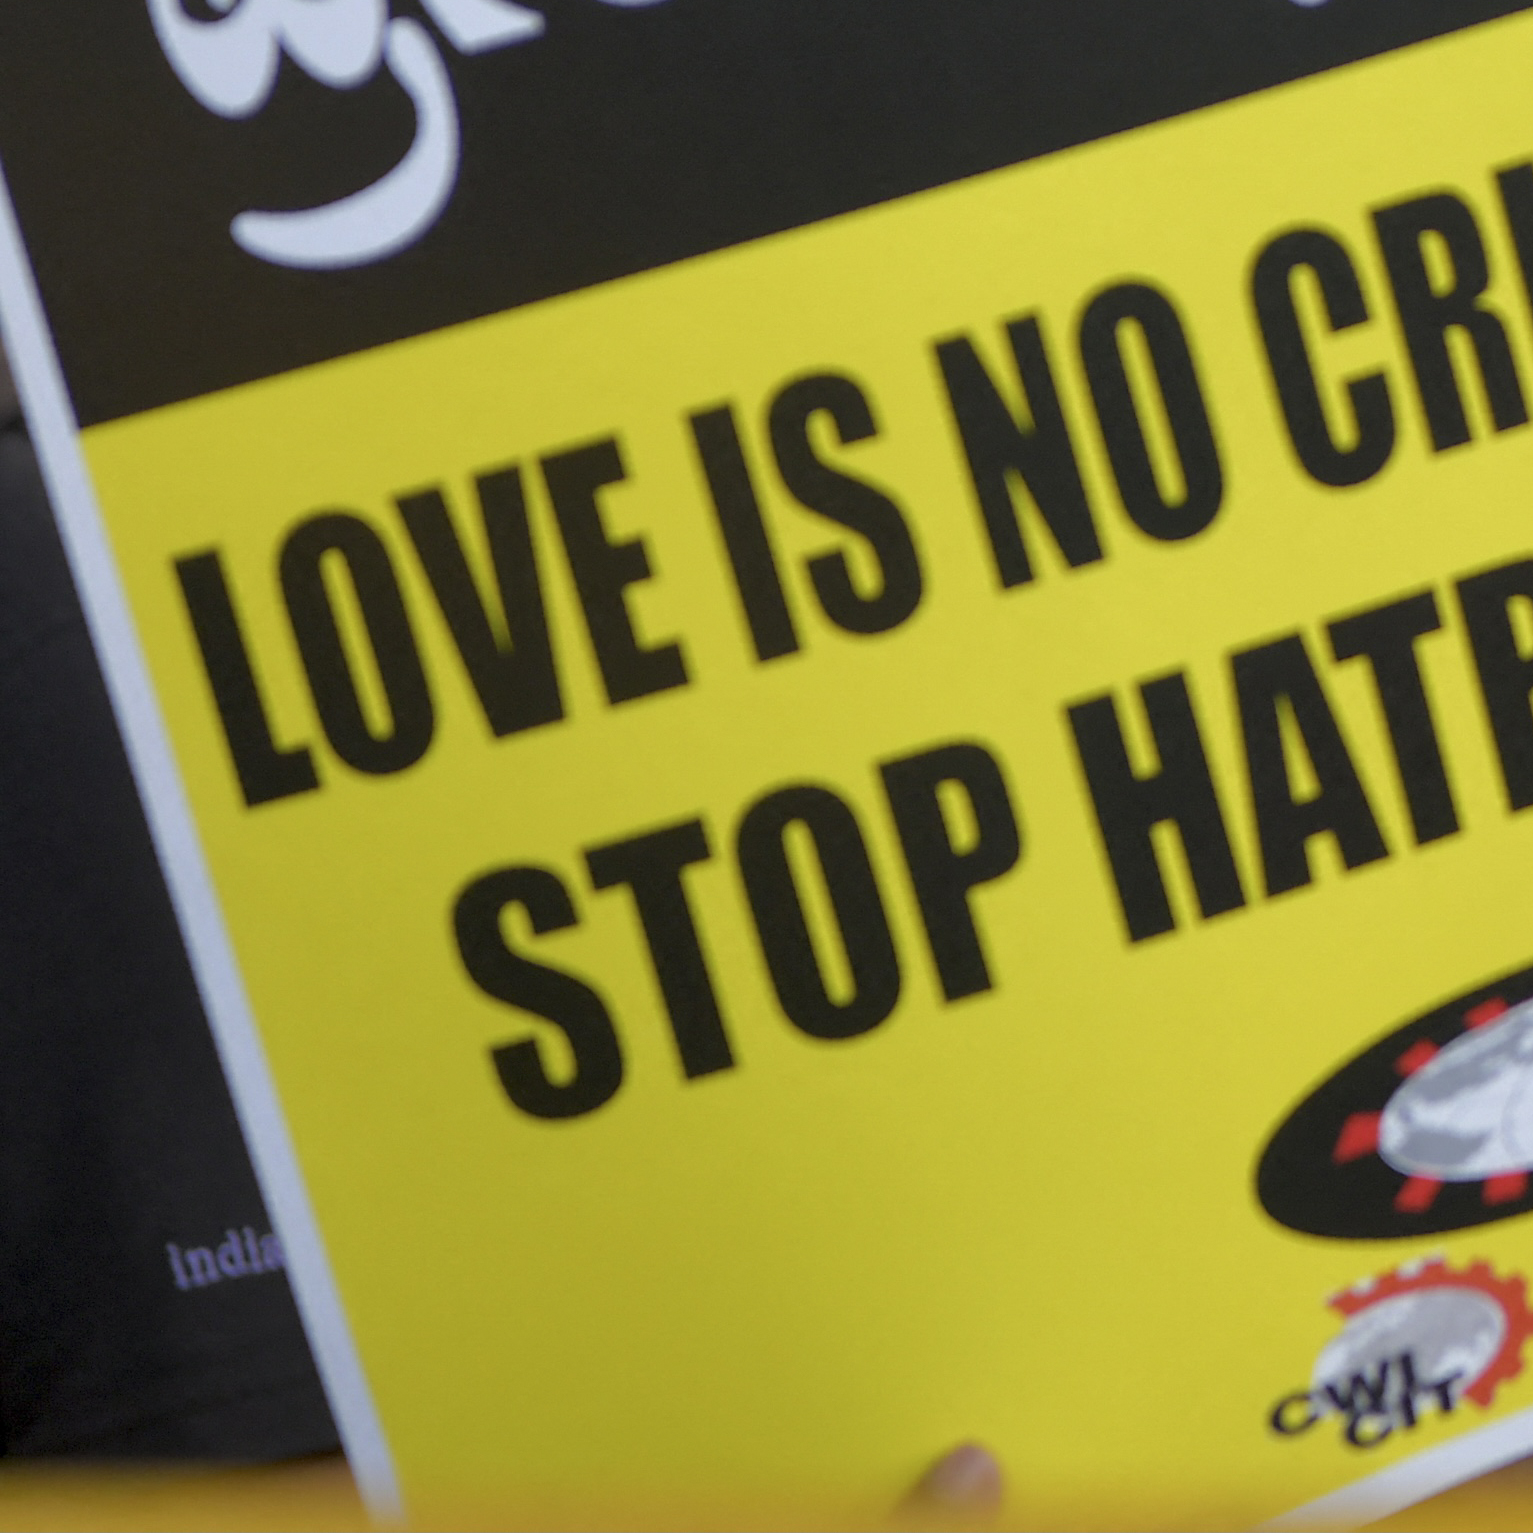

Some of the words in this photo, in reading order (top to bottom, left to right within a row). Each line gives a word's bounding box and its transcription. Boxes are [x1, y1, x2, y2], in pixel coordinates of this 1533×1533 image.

[173, 437, 690, 809] LOVE
[688, 372, 924, 662] IS
[934, 280, 1224, 589] NO
[450, 740, 1024, 1124] STOP
[1268, 1350, 1416, 1436] CWI
[1344, 1369, 1465, 1449] CIT
